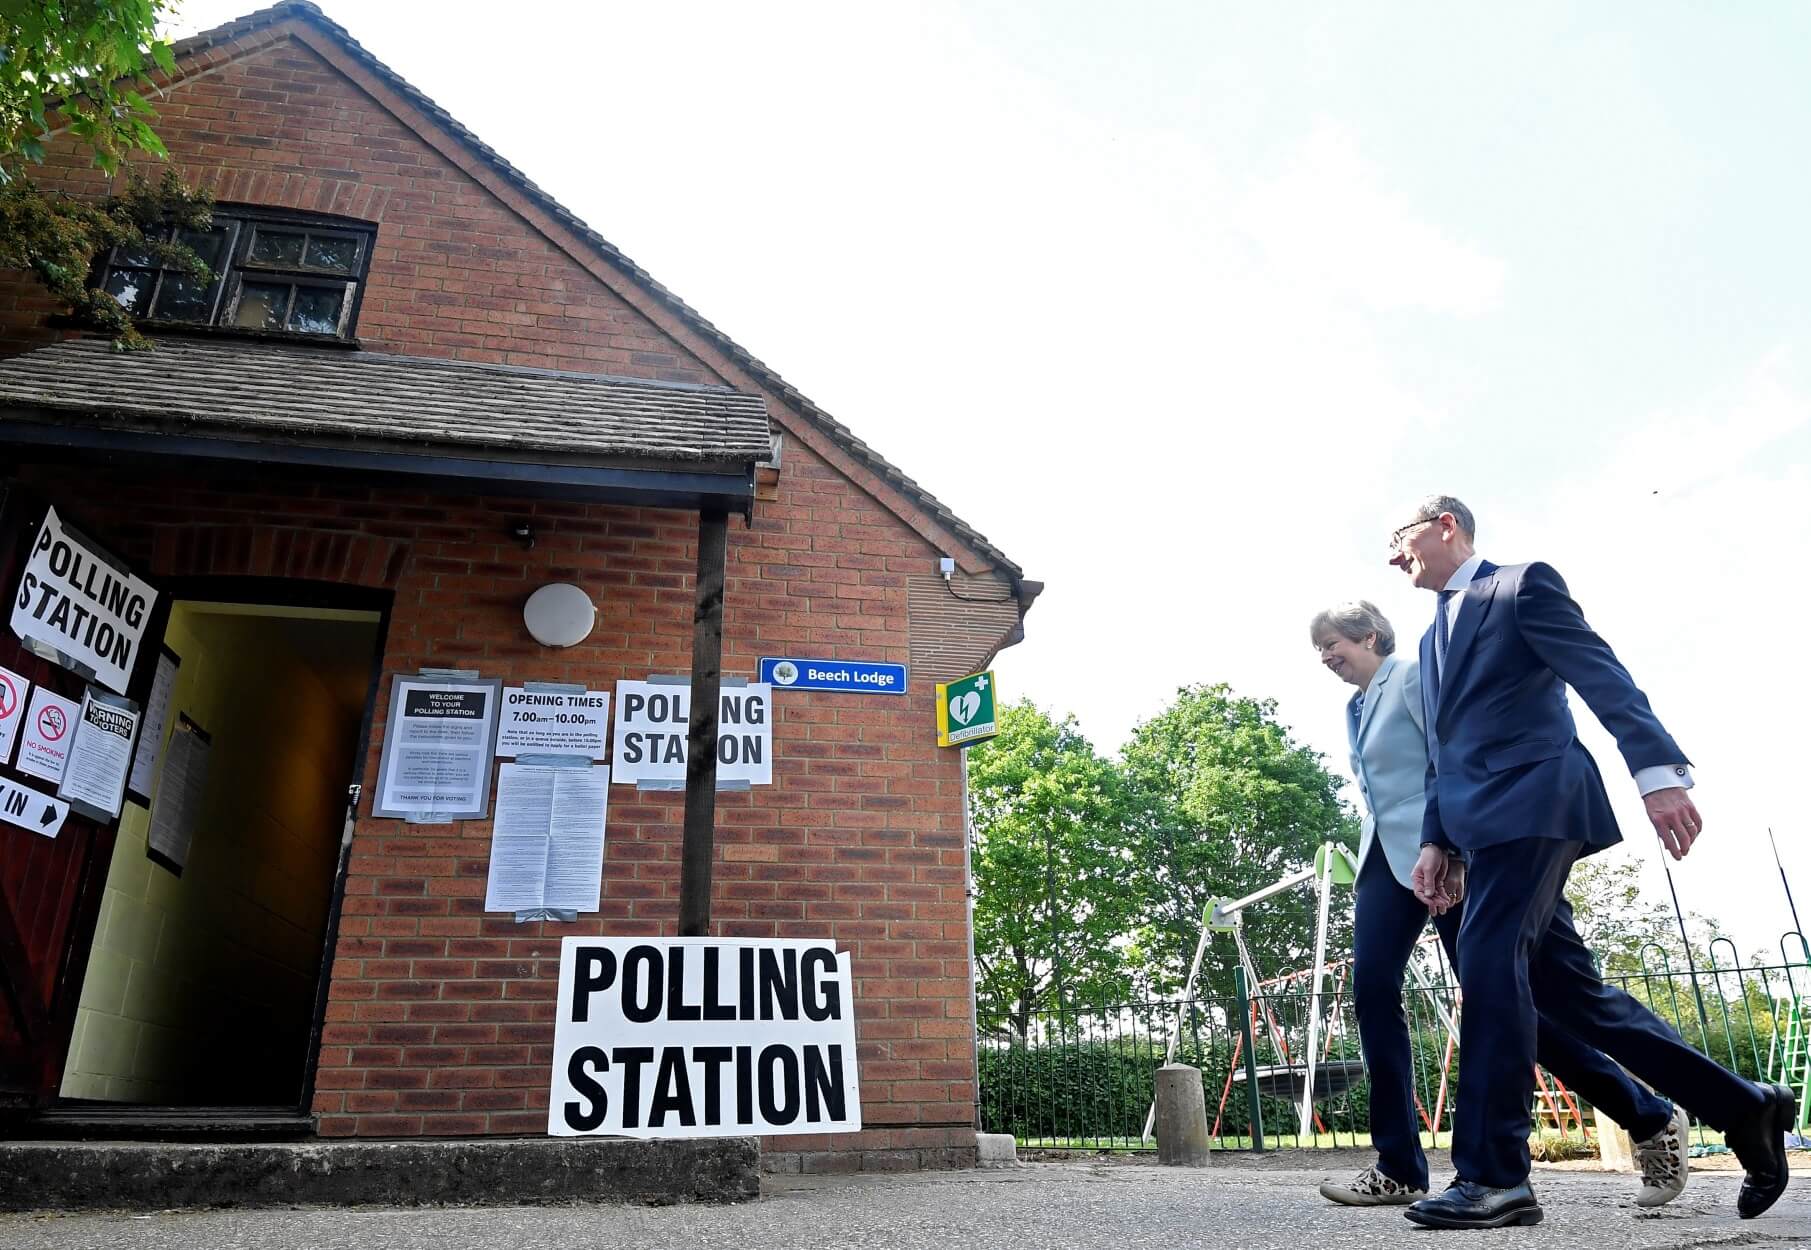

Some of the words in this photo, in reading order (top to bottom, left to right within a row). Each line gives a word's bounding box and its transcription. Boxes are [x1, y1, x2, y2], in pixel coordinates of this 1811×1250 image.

[33, 524, 146, 630] POLLING
[18, 572, 131, 671] STATION
[808, 668, 850, 682] Beech
[854, 671, 894, 686] Lodge
[428, 693, 465, 701] WELCOME
[508, 693, 563, 706] OPENING
[567, 696, 604, 708] TIMES
[623, 693, 764, 725] POLNG
[950, 725, 994, 740] Defibrillator
[26, 740, 37, 749] NO
[37, 744, 65, 760] SMOKING
[623, 732, 762, 765] STAON
[4, 789, 29, 817] IN
[571, 944, 842, 1024] POLLING
[563, 1043, 848, 1132] STATION
